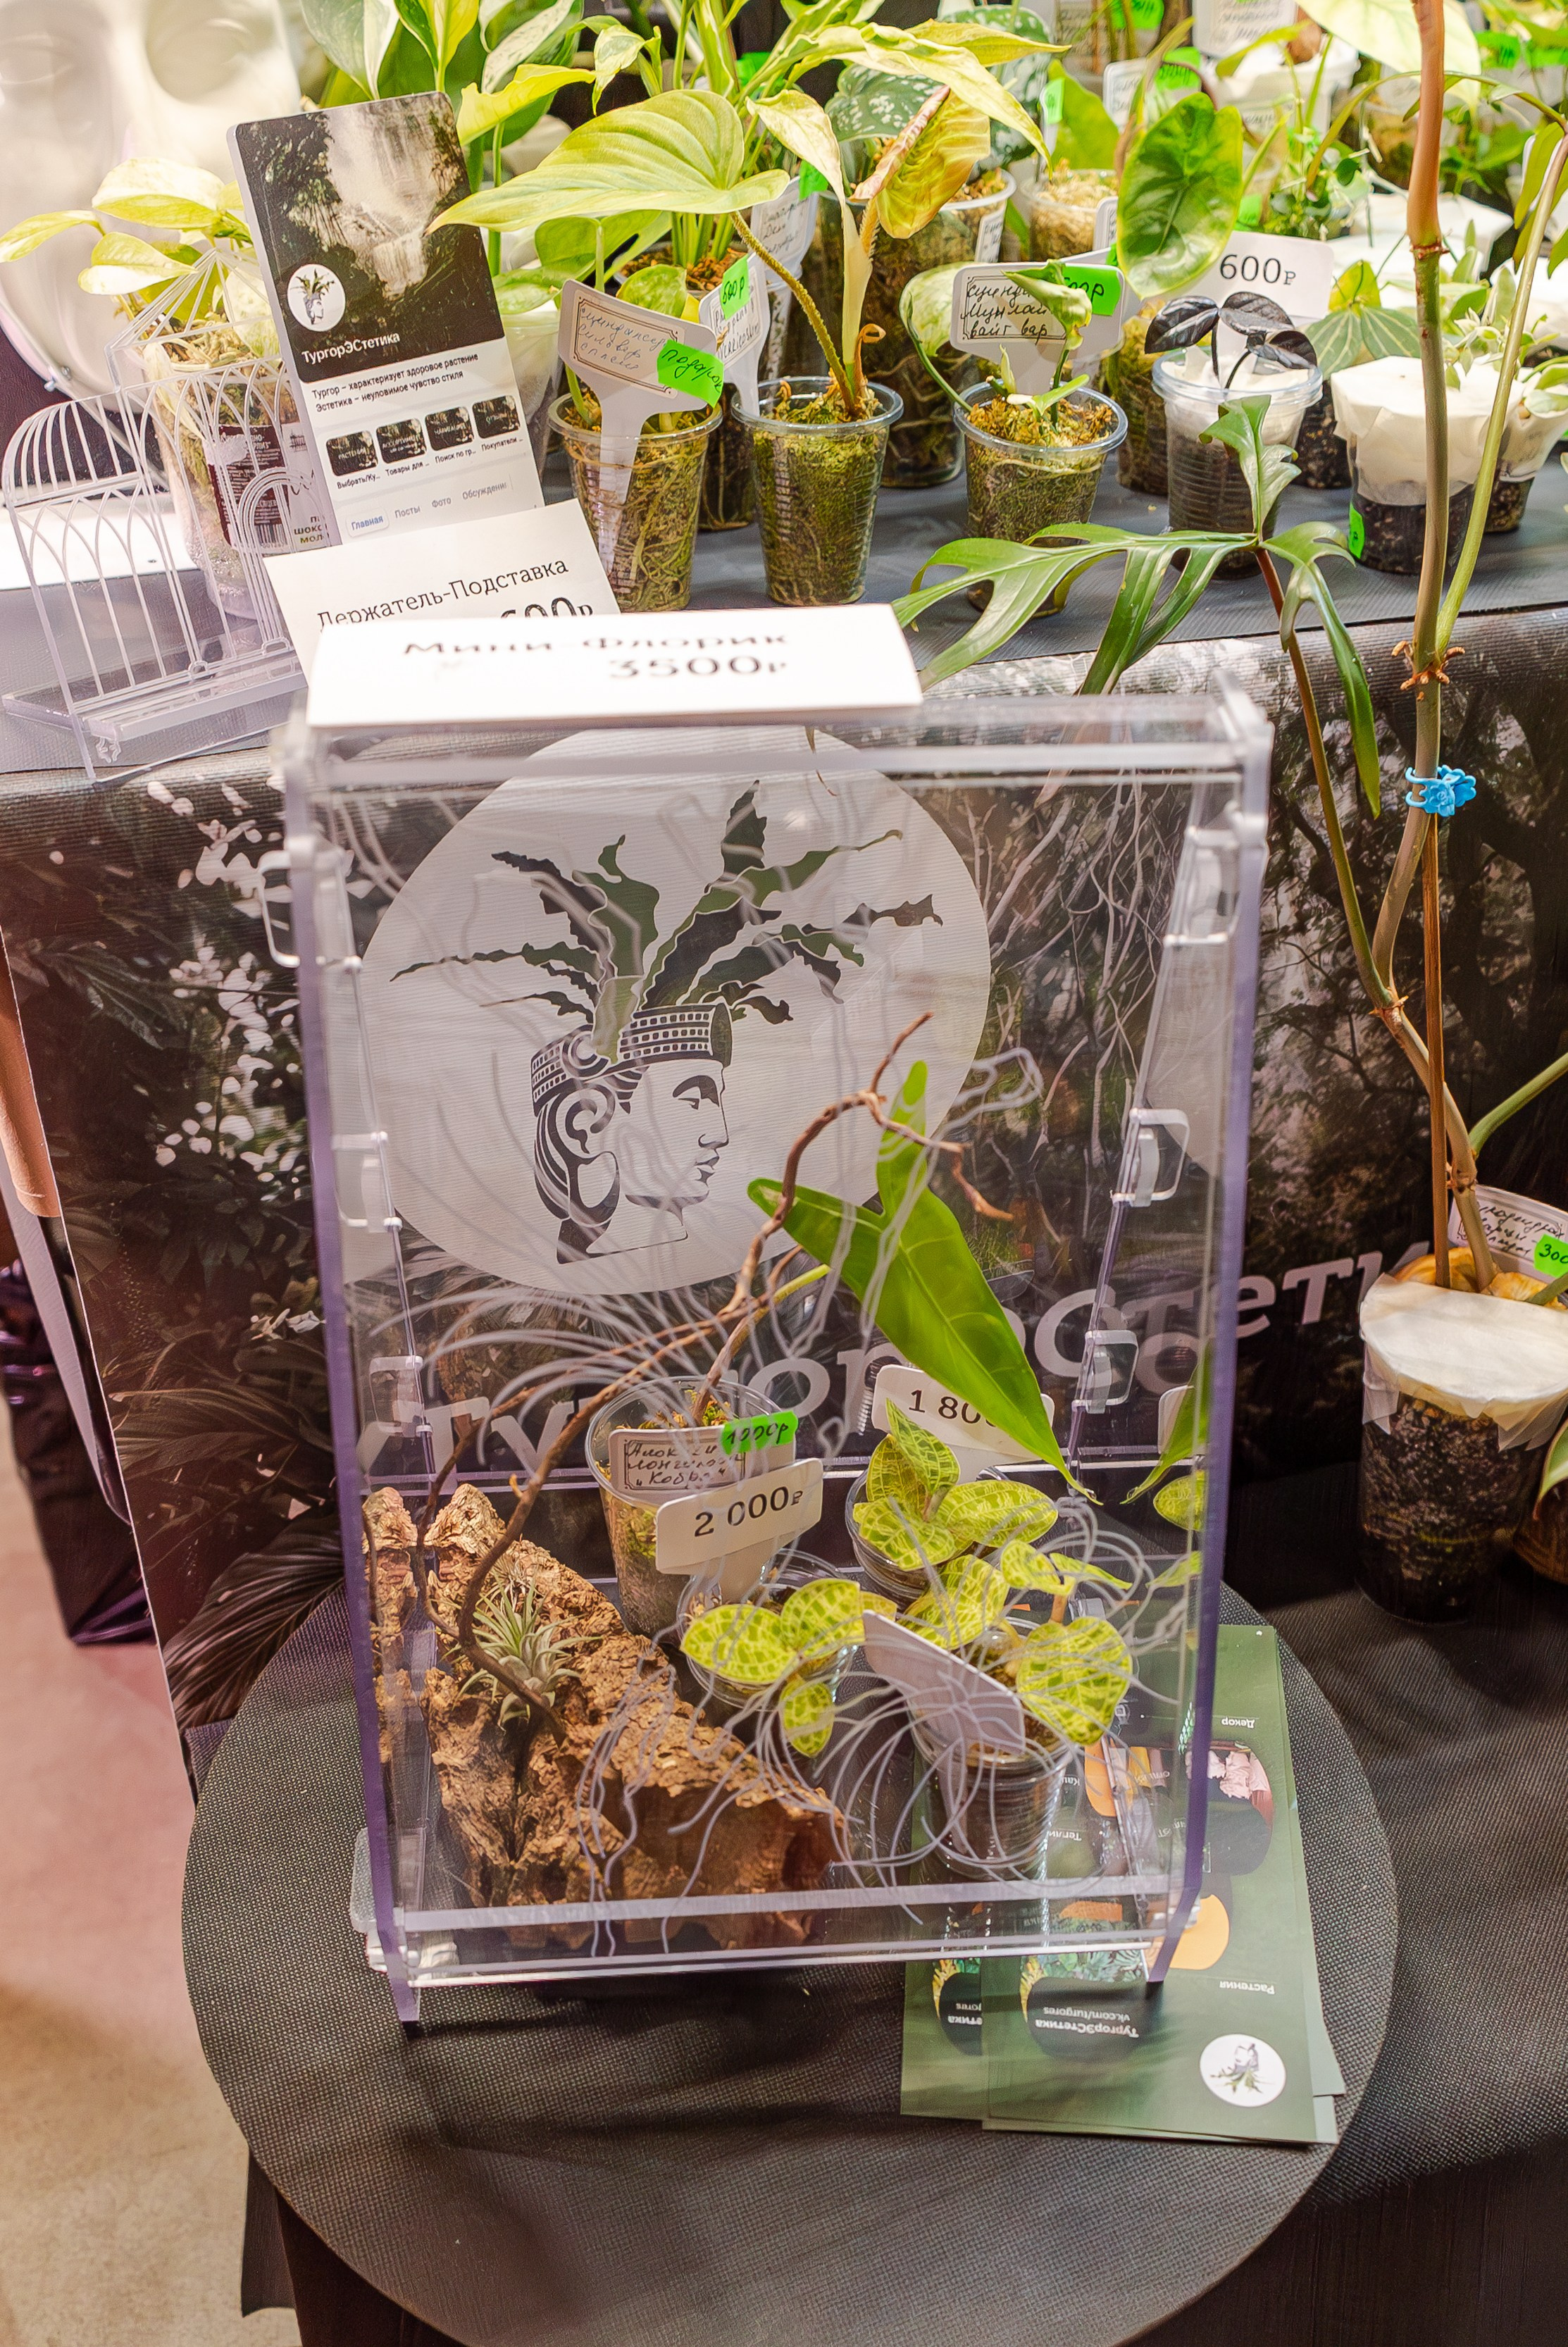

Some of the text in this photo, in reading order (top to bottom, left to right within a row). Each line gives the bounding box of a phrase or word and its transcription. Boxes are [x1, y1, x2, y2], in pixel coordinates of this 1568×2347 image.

[301, 331, 401, 364] ТургорЭСтетика
[311, 386, 340, 400] Тургор
[348, 370, 406, 391] характеризует
[406, 361, 443, 378] здоровое
[444, 353, 479, 371] растение
[316, 397, 353, 413] Эстетика
[361, 383, 409, 404] неуловимое
[409, 376, 440, 393] чувство
[441, 371, 464, 383] стиля
[481, 437, 517, 452] Покупатели
[435, 452, 455, 464] Поиск
[456, 451, 464, 459] по
[385, 462, 424, 478] Товары для
[351, 515, 384, 531] Главная
[394, 505, 421, 519] Посты
[431, 496, 452, 509] Фото
[317, 560, 569, 634] Держатель-Подставка
[404, 635, 788, 655] Мини Флорик
[938, 1395, 997, 1428] 80
[1221, 1718, 1255, 1729] Декор
[1219, 1980, 1276, 1995] Растения
[1043, 2006, 1131, 2022] vk.com/turgores
[1035, 2019, 1140, 2038] ТургорЭСтетика
